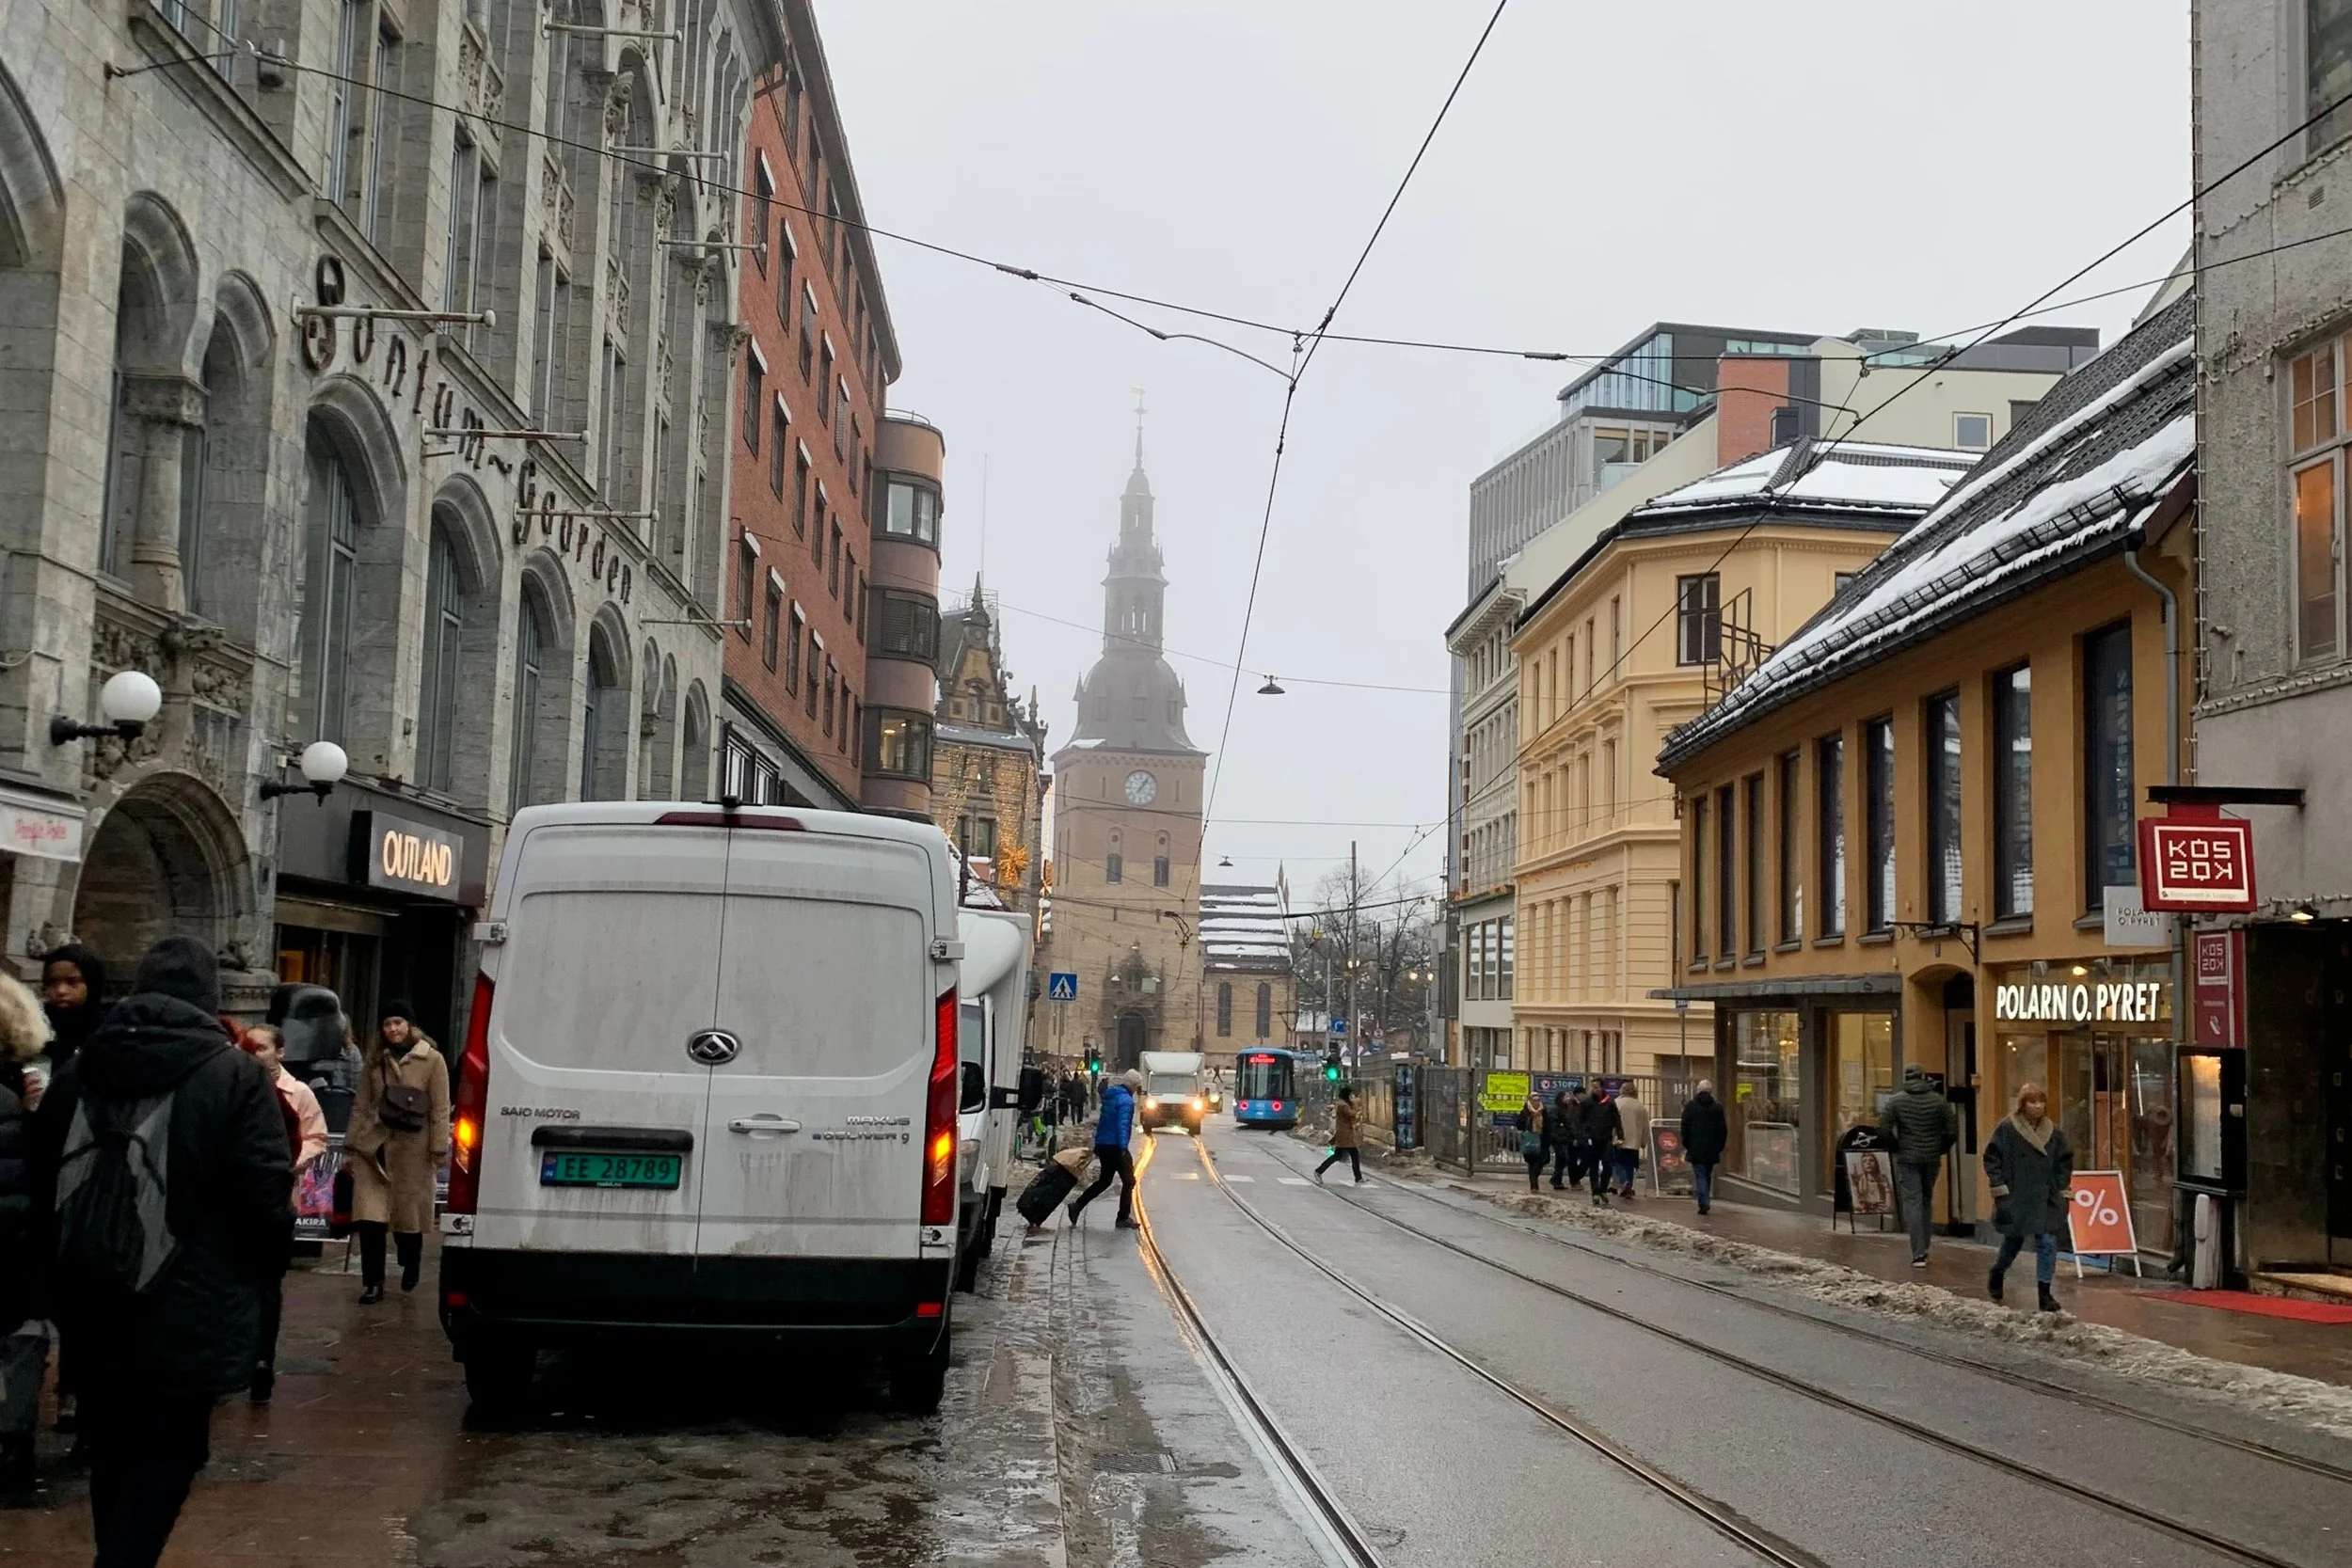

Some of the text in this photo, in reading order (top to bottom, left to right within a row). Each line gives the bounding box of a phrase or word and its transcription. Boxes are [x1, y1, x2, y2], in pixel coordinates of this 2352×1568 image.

[383, 830, 453, 886] OUTLAND
[1995, 983, 2160, 1022] POLARN O. PYRET
[501, 1106, 580, 1120] SAIC MOTOR
[847, 1116, 911, 1126] MAXUS
[901, 1132, 910, 1145] 9
[564, 1158, 671, 1180] EE 28789
[294, 1217, 326, 1227] AKIRA
